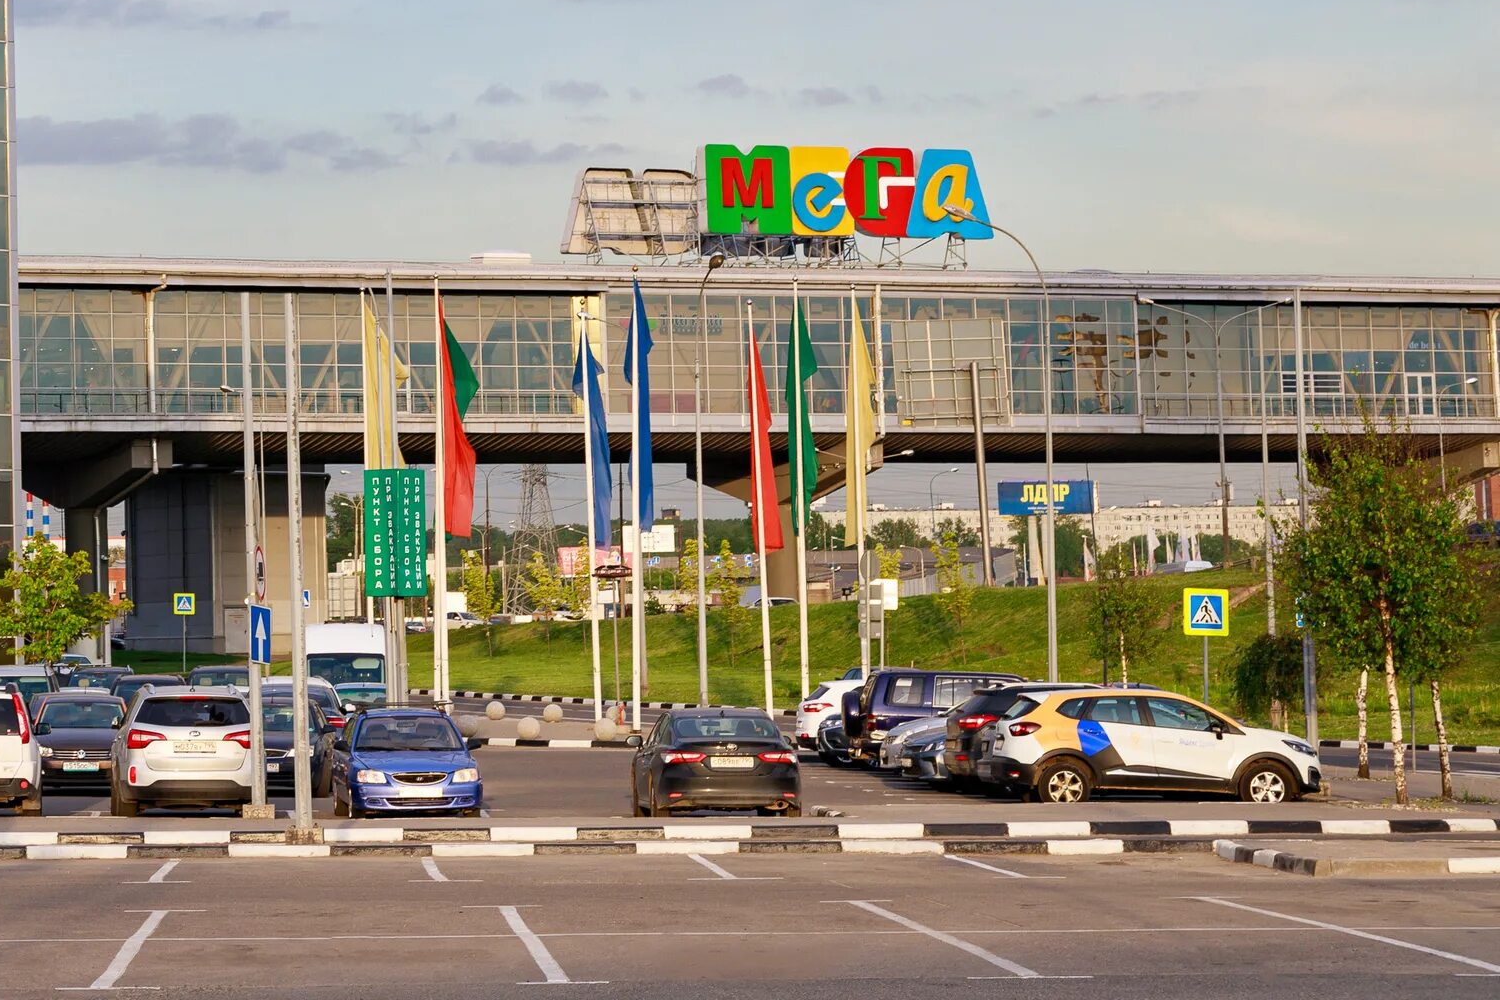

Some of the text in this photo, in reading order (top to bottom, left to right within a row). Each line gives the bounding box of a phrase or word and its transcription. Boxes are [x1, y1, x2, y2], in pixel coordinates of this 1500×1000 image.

[372, 477, 383, 589] ПУНКТ СБОРА
[387, 511, 396, 589] ЭВАКУАЦИИ
[404, 534, 412, 589] СБОРА
[415, 511, 423, 589] ЭВАКУАЦИИ
